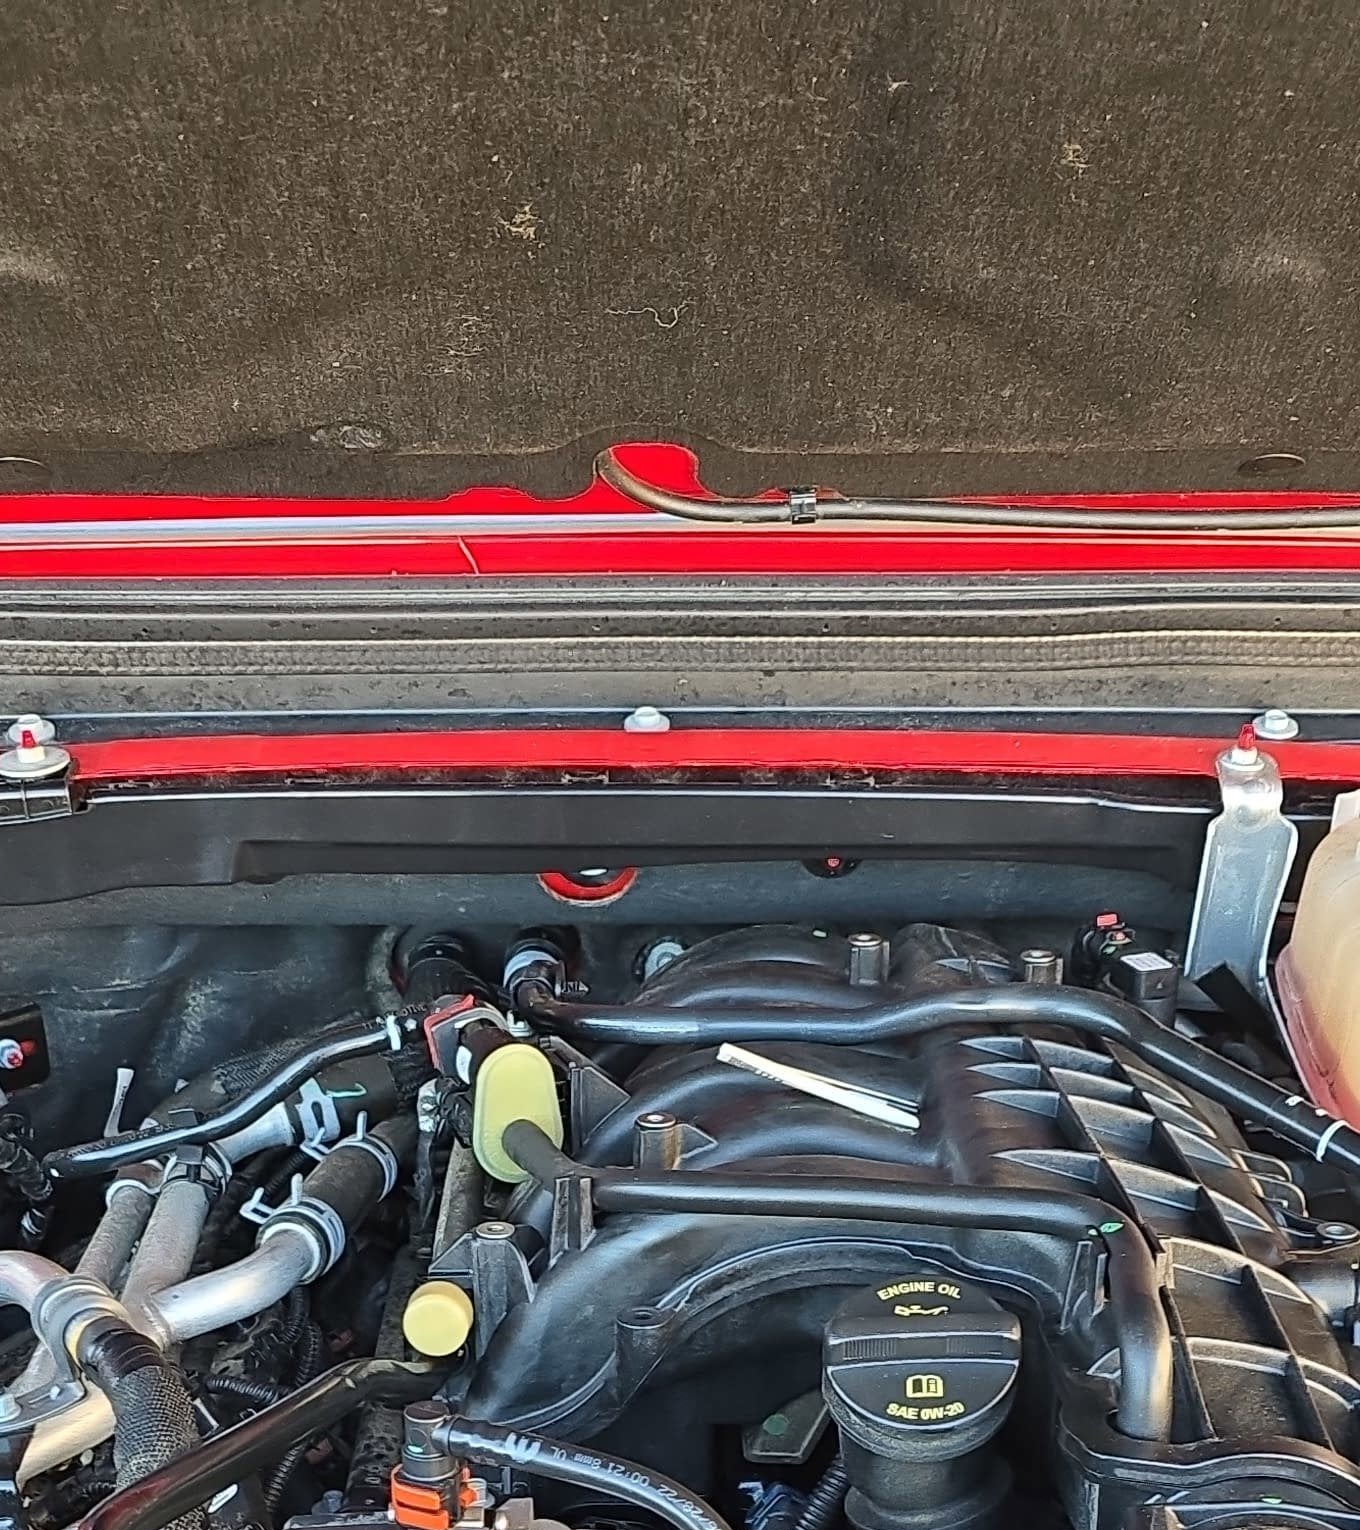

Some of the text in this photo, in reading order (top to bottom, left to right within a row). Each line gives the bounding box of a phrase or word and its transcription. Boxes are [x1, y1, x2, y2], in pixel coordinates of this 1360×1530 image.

[877, 1281, 962, 1300] ENGINE OIL
[886, 1402, 965, 1420] SAE 0W-20
